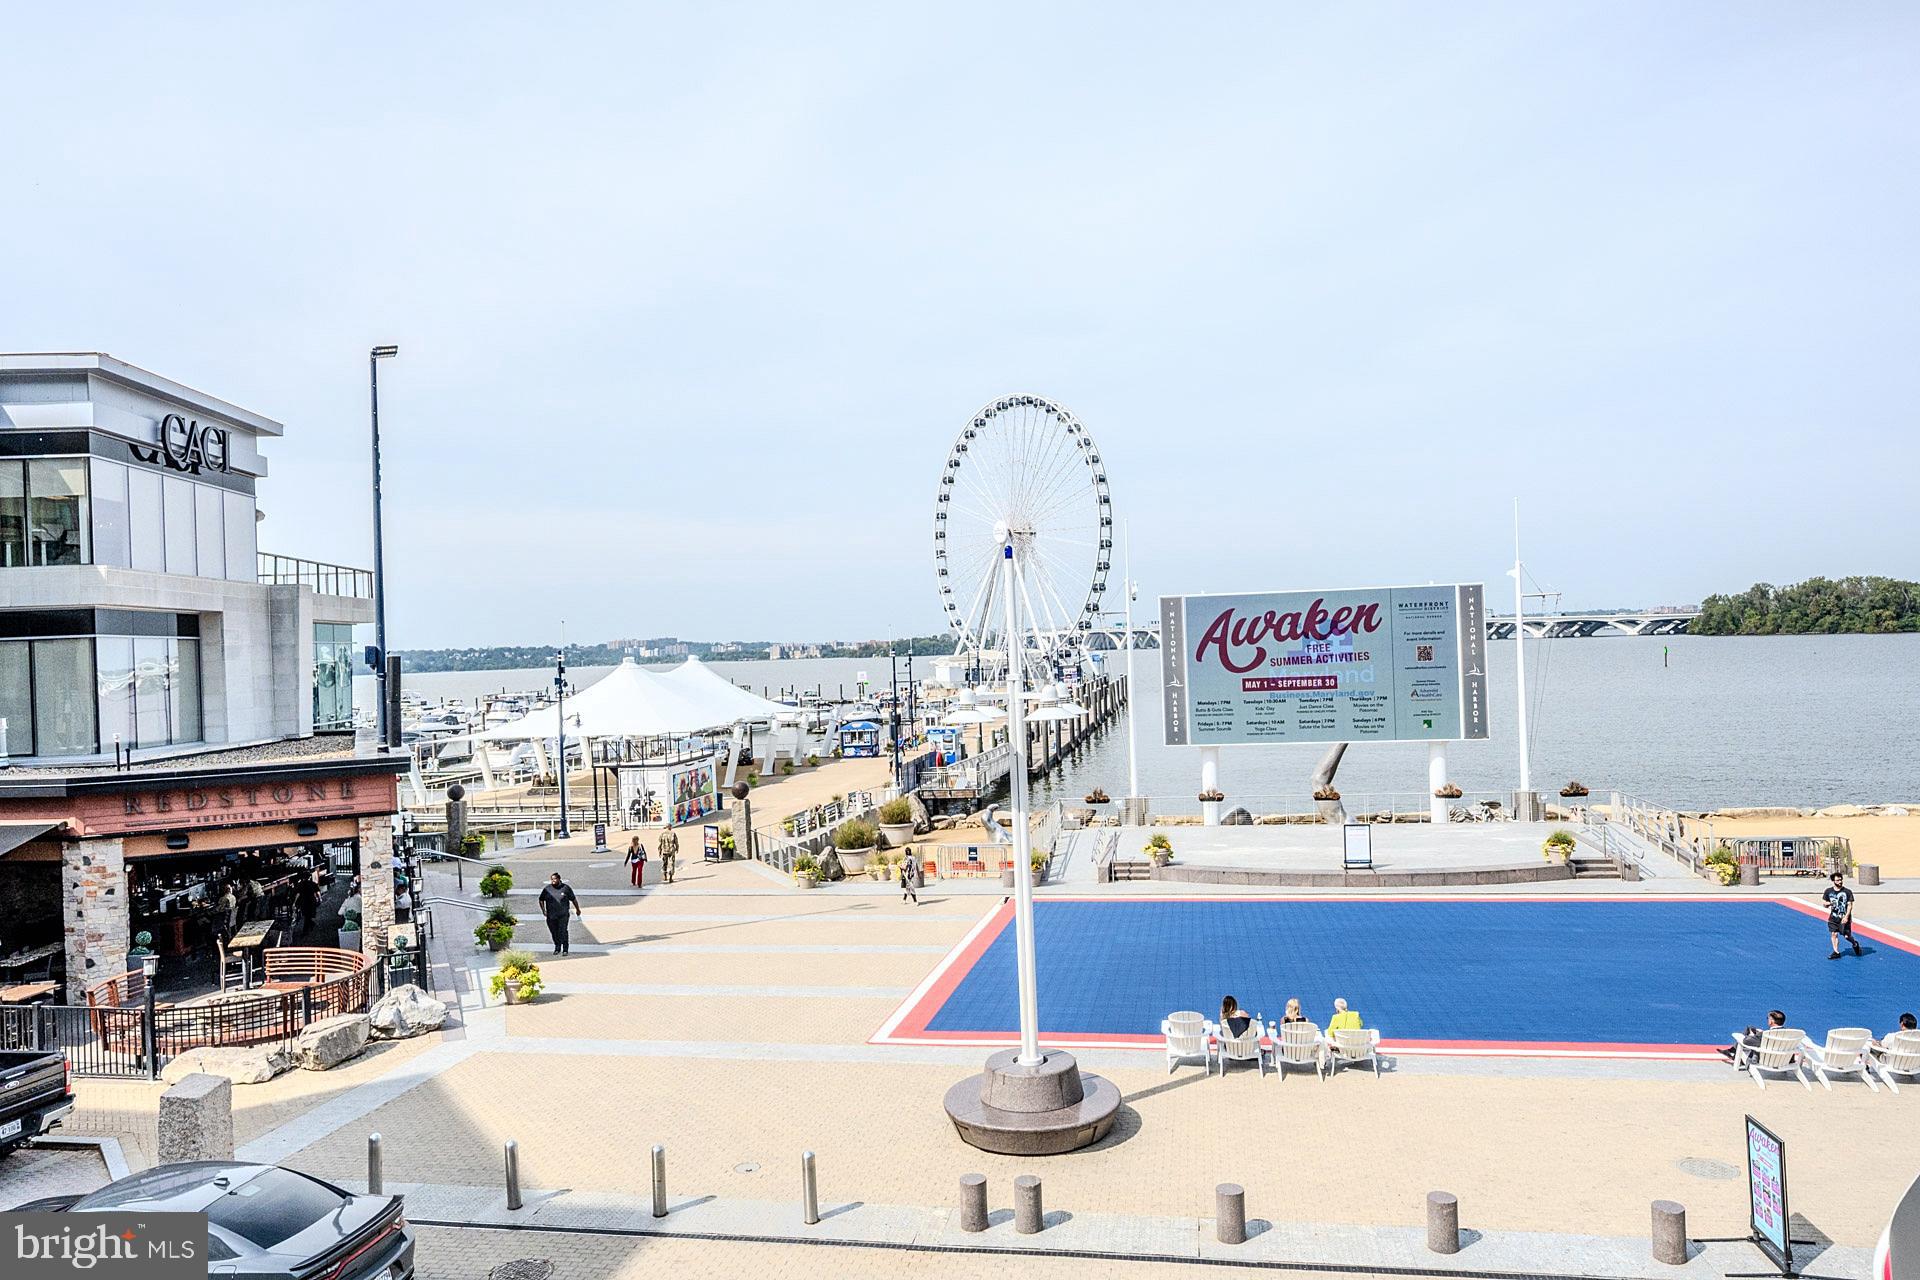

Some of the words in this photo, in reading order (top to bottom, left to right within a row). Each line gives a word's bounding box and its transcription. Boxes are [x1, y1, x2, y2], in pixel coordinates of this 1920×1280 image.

[161, 413, 232, 474] CACI
[1169, 610, 1177, 668] NATIONAL
[1195, 598, 1382, 674] Awaken
[1469, 596, 1477, 656] NATIONAL
[1270, 655, 1313, 667] SUMMER
[1315, 652, 1370, 664] ACTIVITIES
[1306, 643, 1331, 653] FREE
[1245, 681, 1260, 689] MAY
[1278, 679, 1322, 688] SEPTEMBER
[1325, 678, 1335, 687] 30
[1471, 681, 1479, 723] HARBOR
[1172, 691, 1180, 734] HARBOR
[125, 780, 356, 815] REDSTONE
